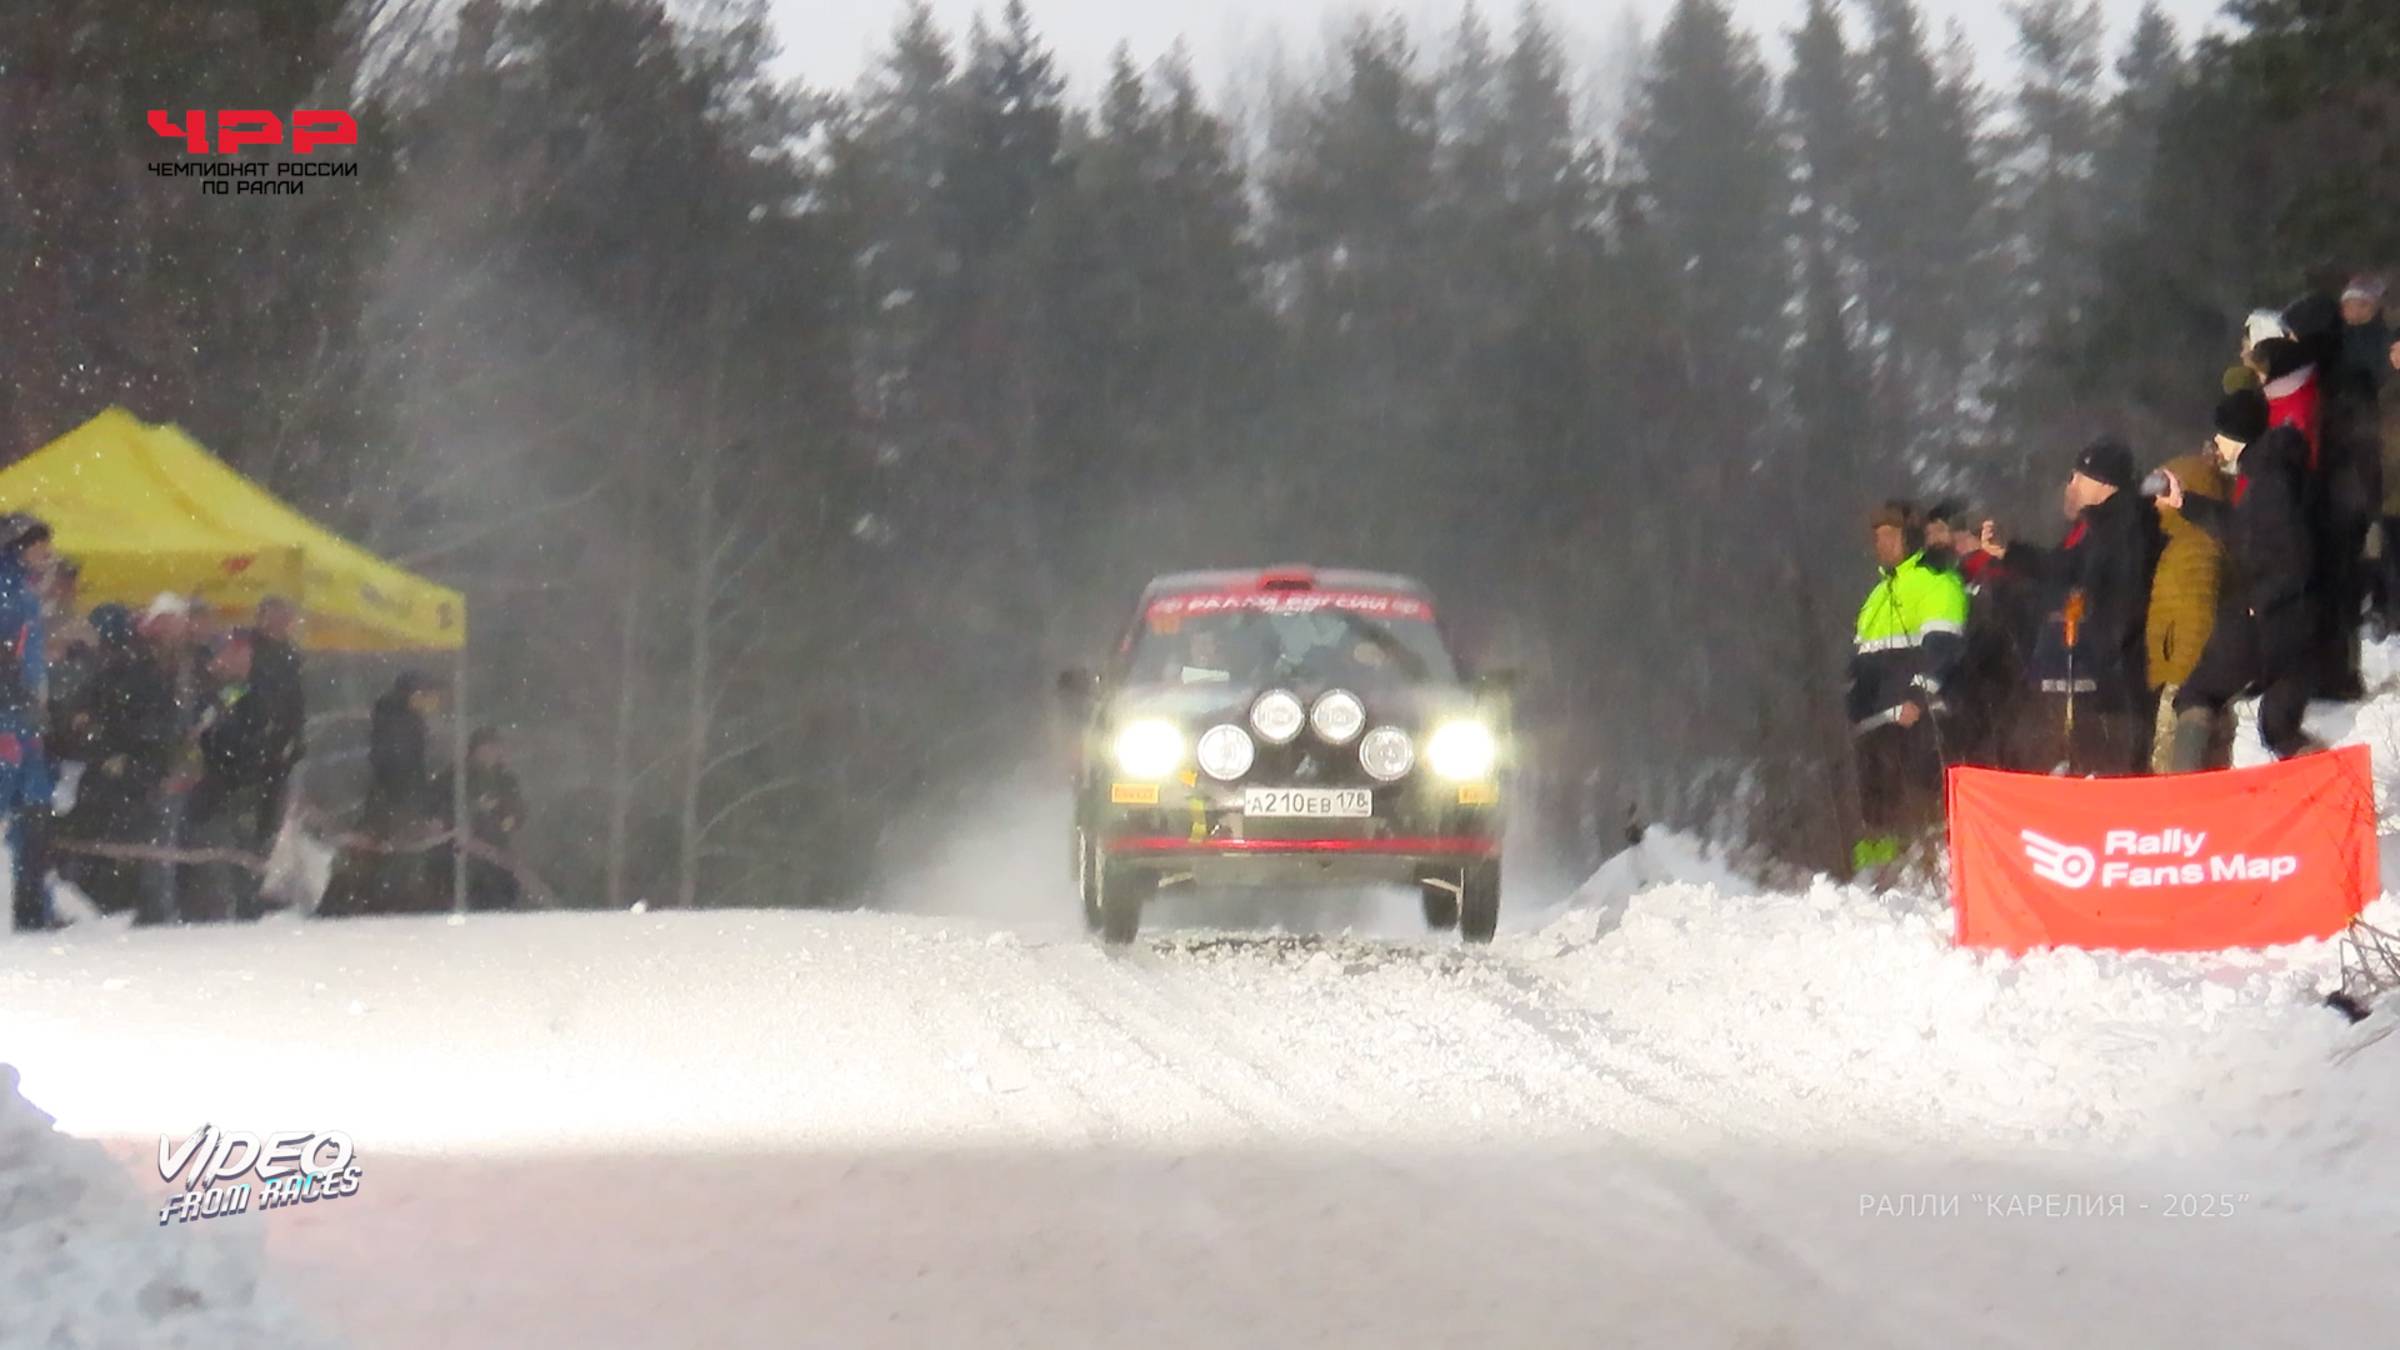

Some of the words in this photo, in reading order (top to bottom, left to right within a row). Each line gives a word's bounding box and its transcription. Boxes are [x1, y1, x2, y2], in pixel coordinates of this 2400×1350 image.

[2104, 828, 2206, 857] Rally
[2102, 861, 2205, 887] Fans
[2209, 853, 2297, 882] Map
